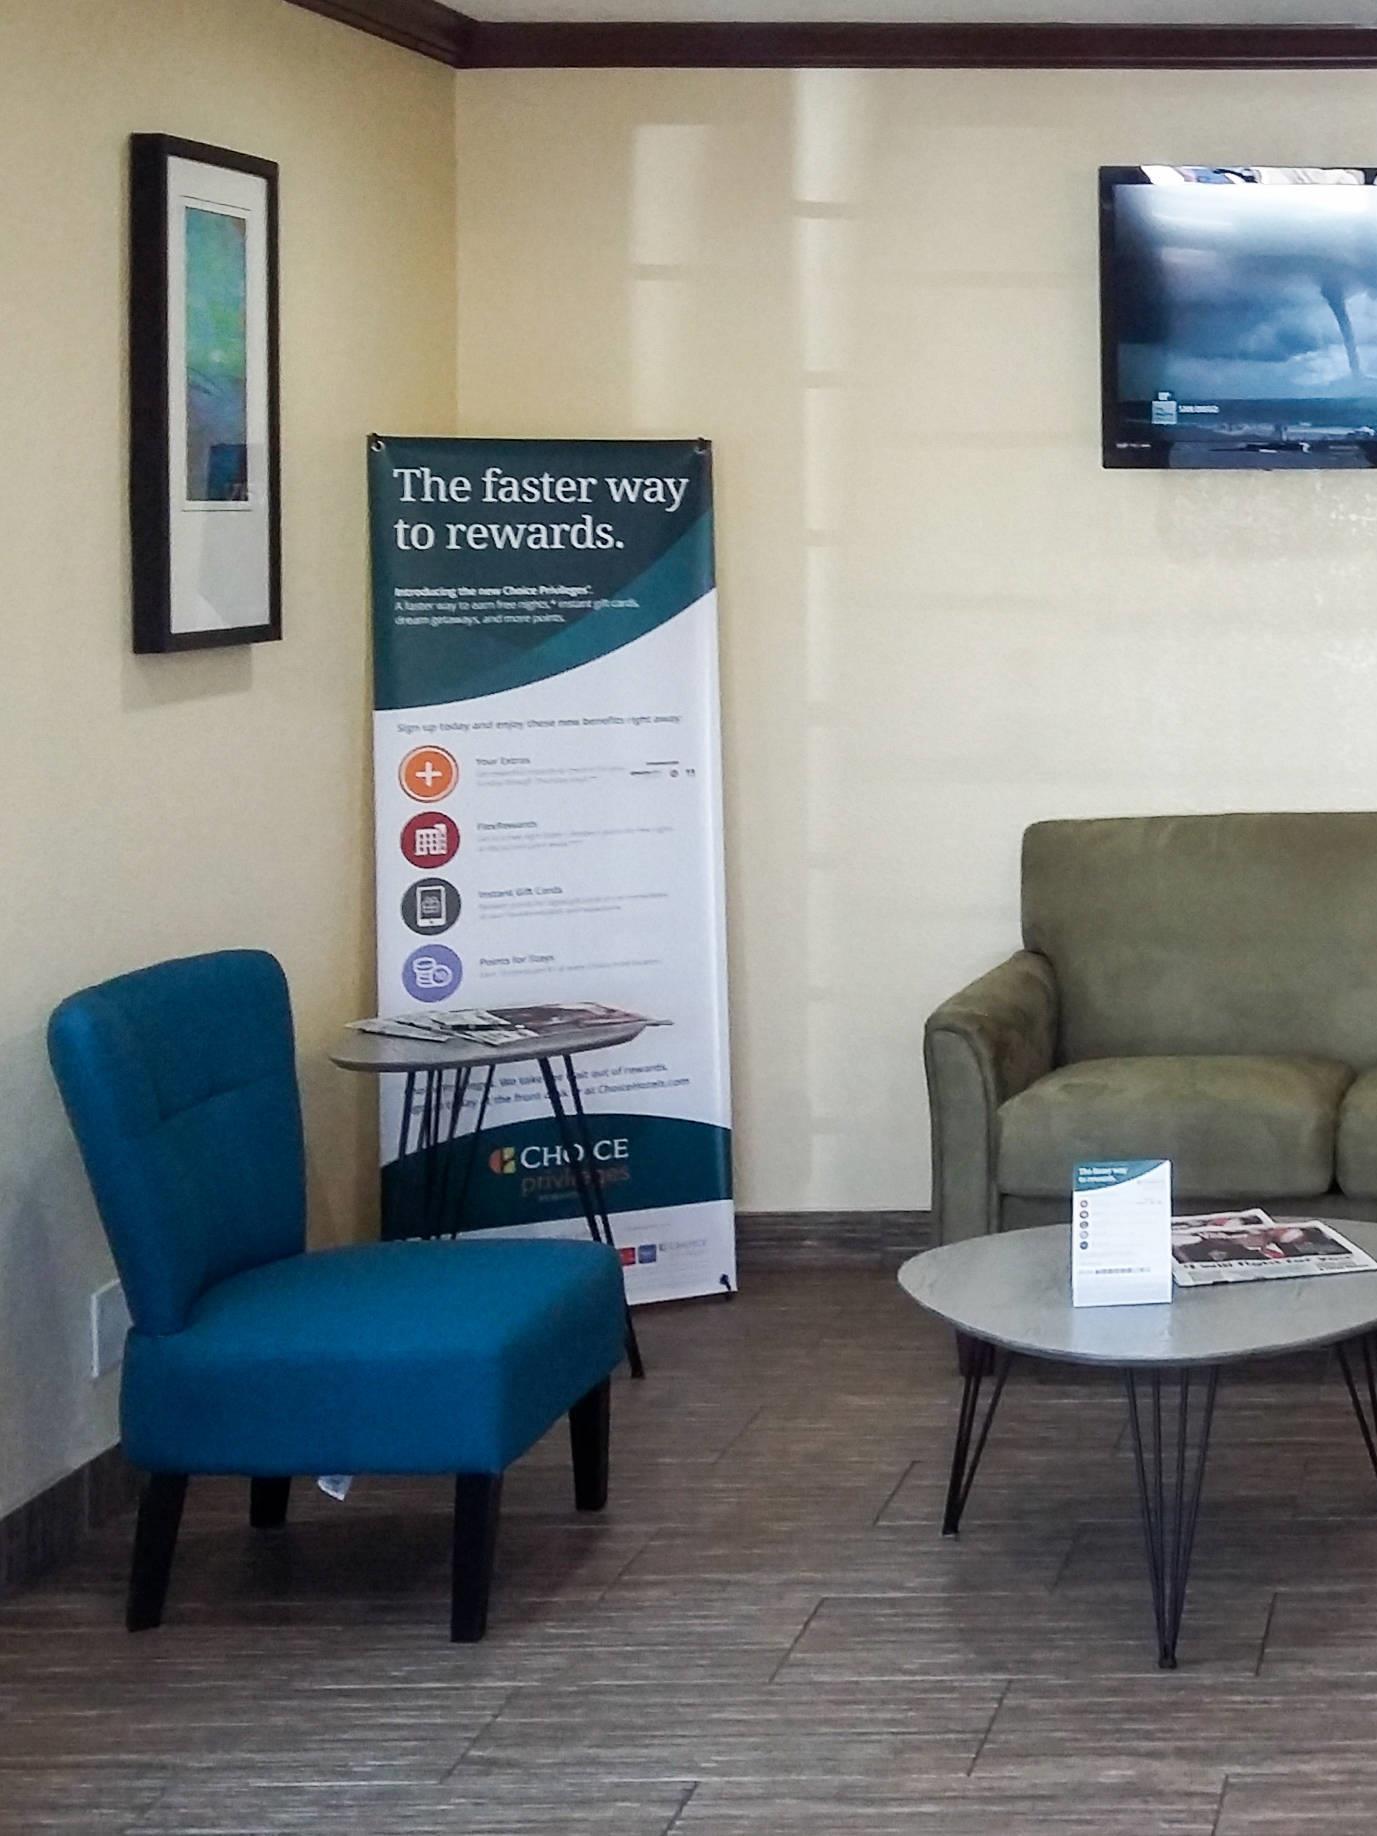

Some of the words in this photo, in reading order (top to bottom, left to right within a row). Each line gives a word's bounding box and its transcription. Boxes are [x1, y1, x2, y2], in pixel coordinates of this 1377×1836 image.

[393, 467, 472, 503] The
[481, 468, 598, 503] faster
[605, 477, 689, 511] way
[394, 517, 435, 550] to
[445, 514, 625, 550] rewards.
[394, 587, 458, 599] Introducing
[458, 586, 477, 597] the
[478, 587, 501, 596] new
[503, 586, 537, 596] Choice
[520, 1138, 629, 1169] CHOCE
